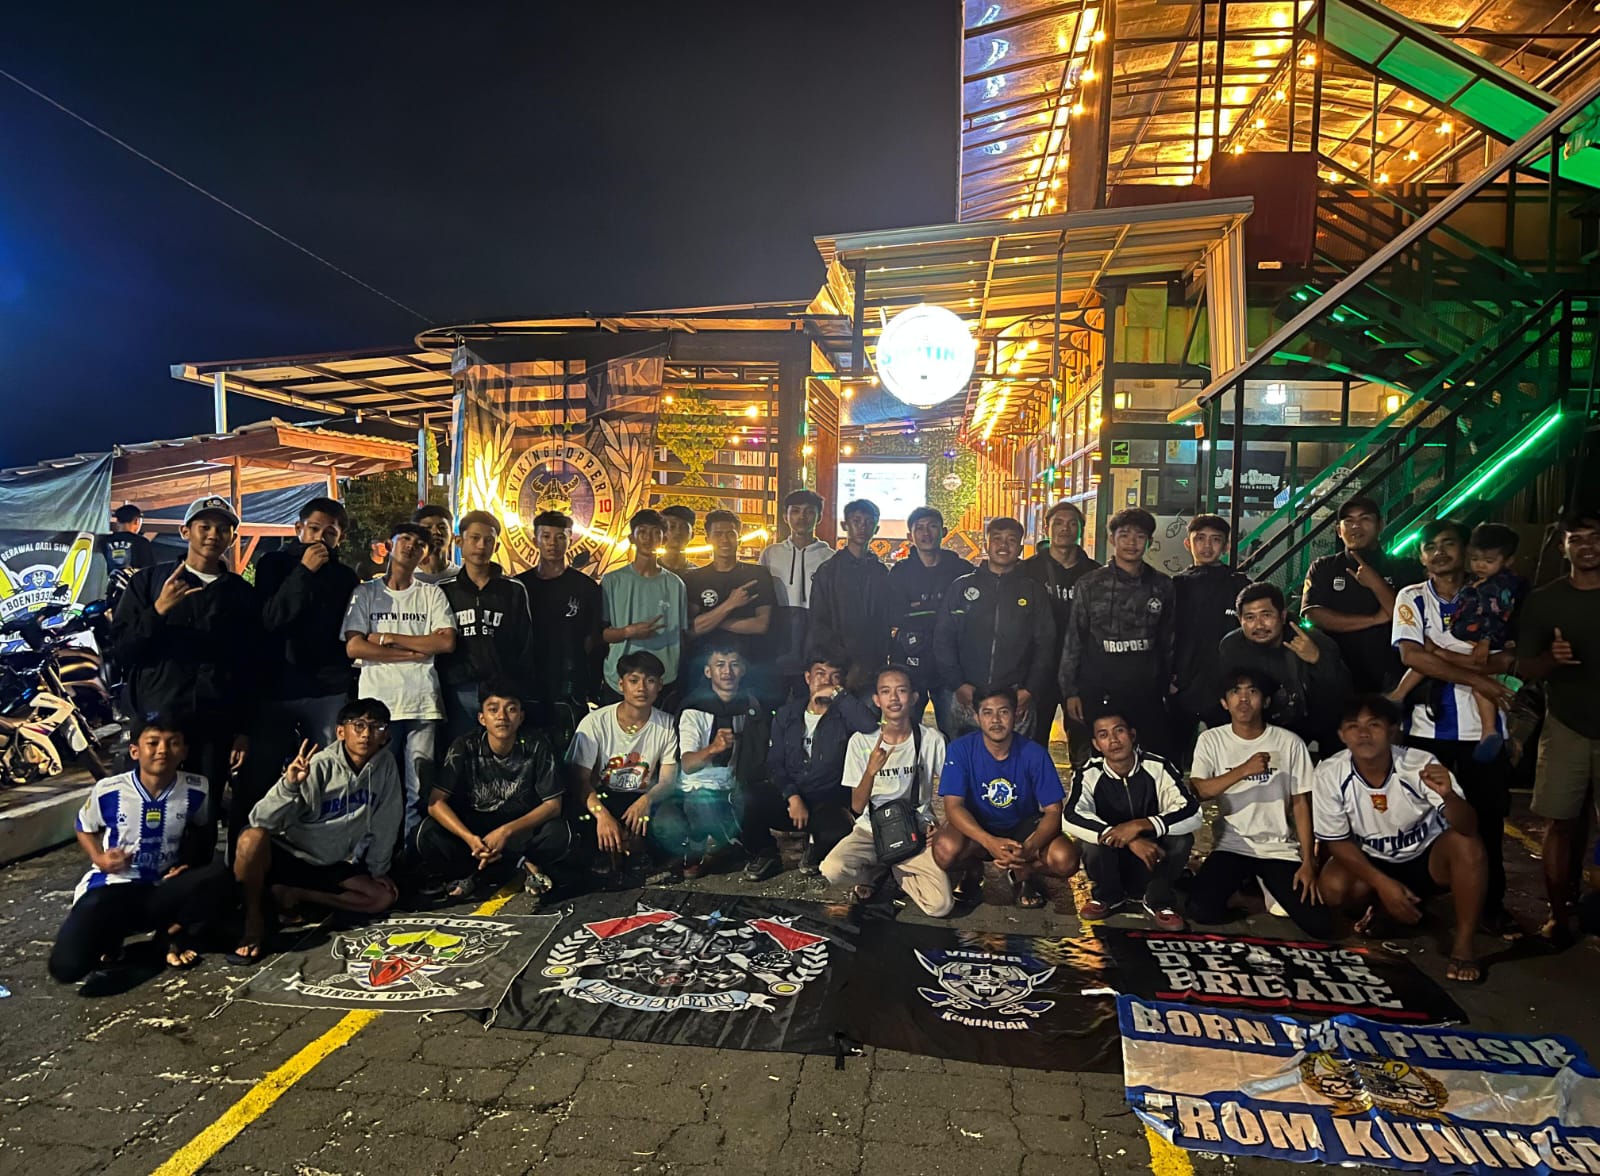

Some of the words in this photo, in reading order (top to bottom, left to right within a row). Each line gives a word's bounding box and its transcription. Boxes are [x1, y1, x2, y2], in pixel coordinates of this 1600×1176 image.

[598, 499, 612, 513] 10
[370, 612, 398, 621] CRTW
[402, 612, 427, 622] BOYS
[1161, 967, 1404, 1009] BRIGADE
[940, 1010, 1029, 1030] KUNINGAN
[1130, 1001, 1275, 1047] BORN
[1378, 1029, 1576, 1068] PERSIB
